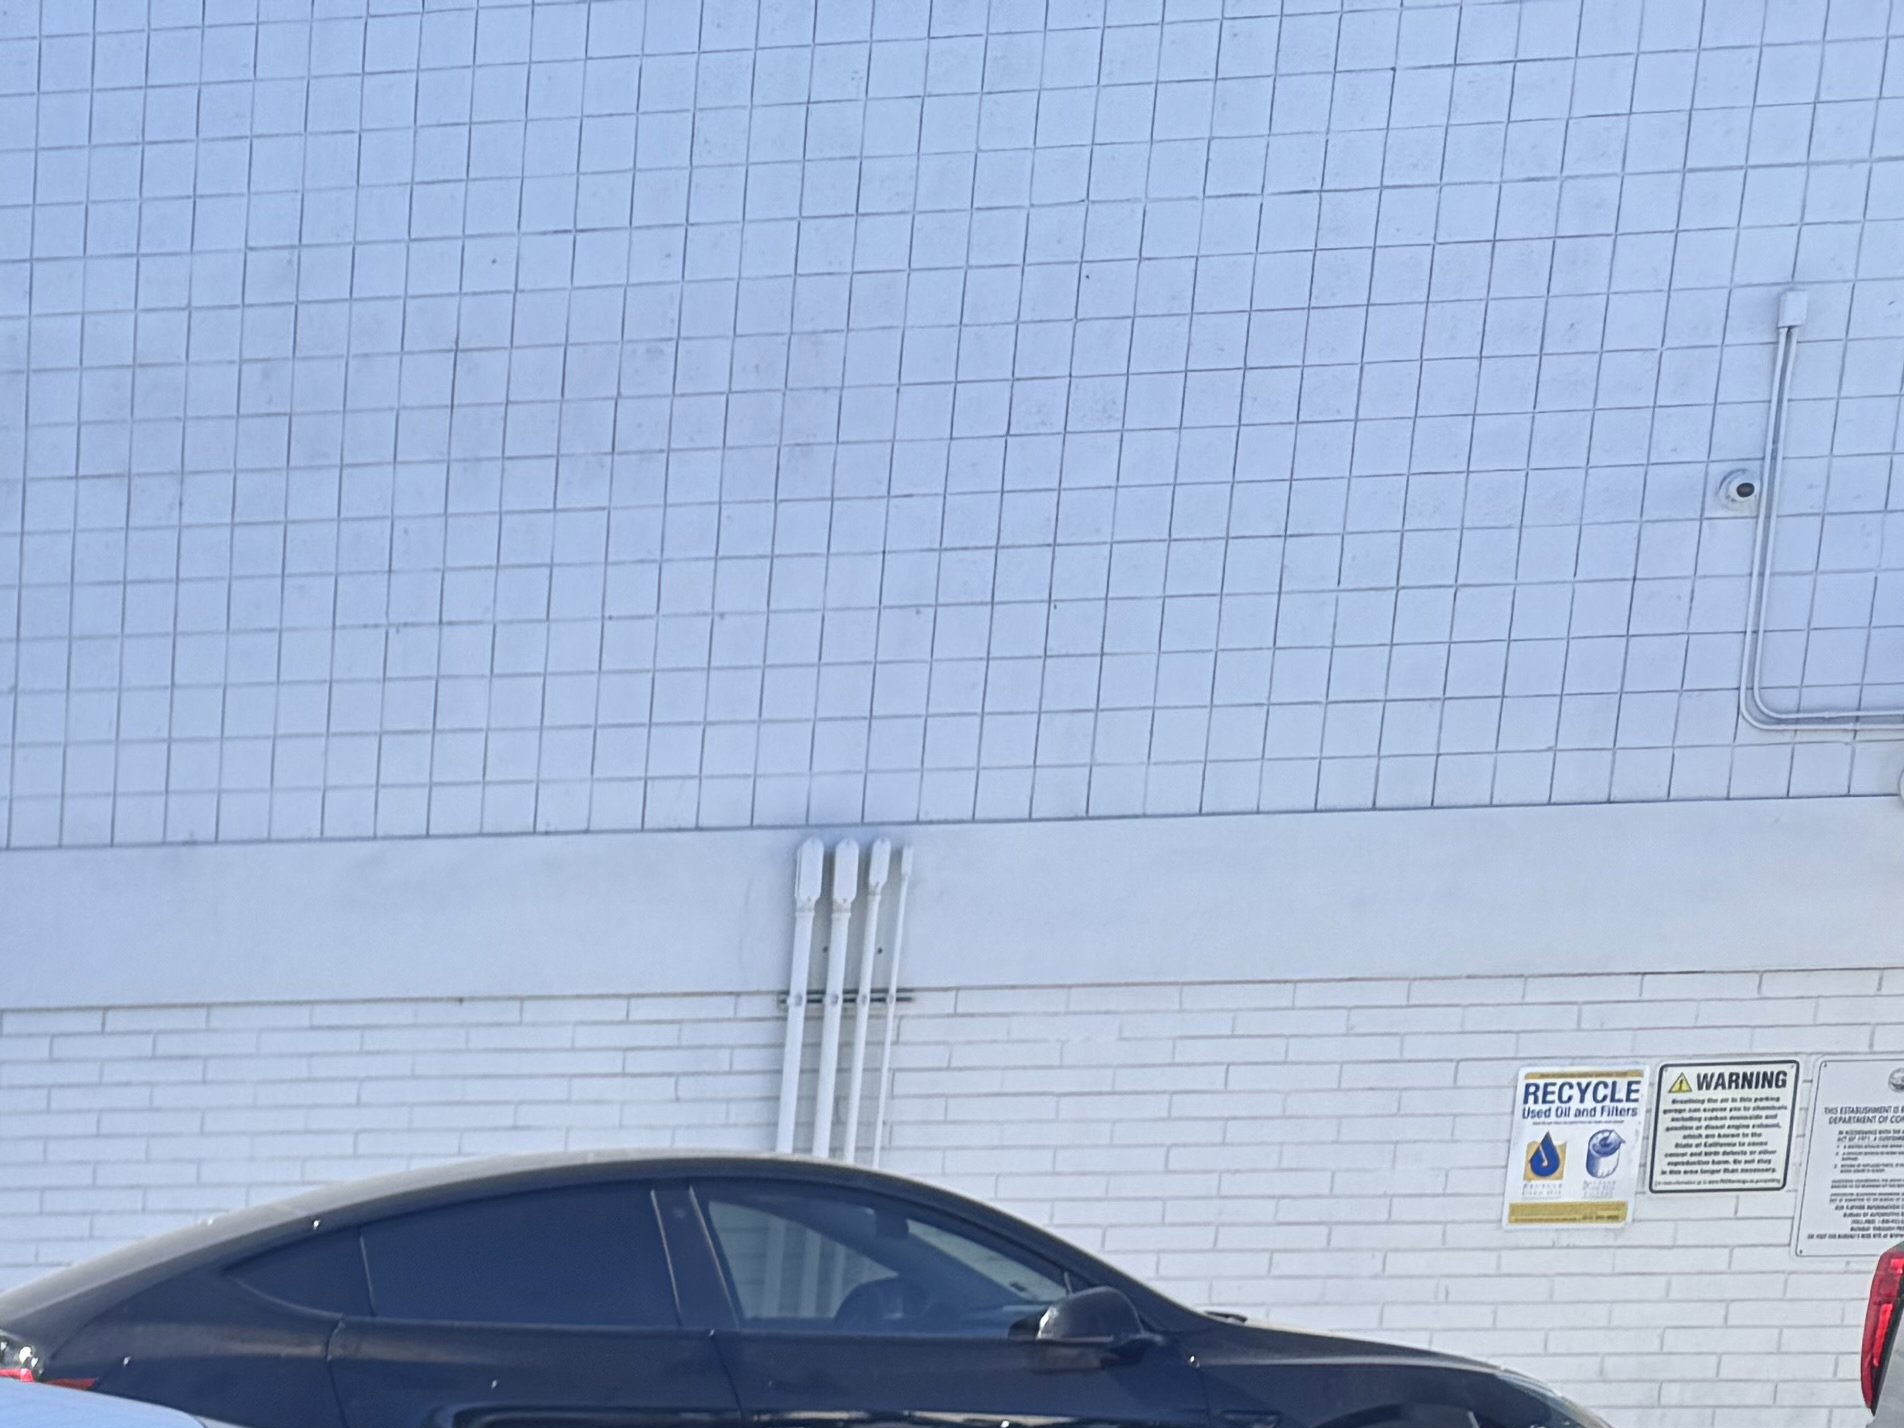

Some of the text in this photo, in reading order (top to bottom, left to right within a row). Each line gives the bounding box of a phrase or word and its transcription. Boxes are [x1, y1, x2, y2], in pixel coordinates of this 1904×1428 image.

[1696, 1070, 1788, 1091] WARNING
[1523, 1080, 1642, 1105] RECYCLE
[1522, 1105, 1638, 1119] Used Oil and Filters
